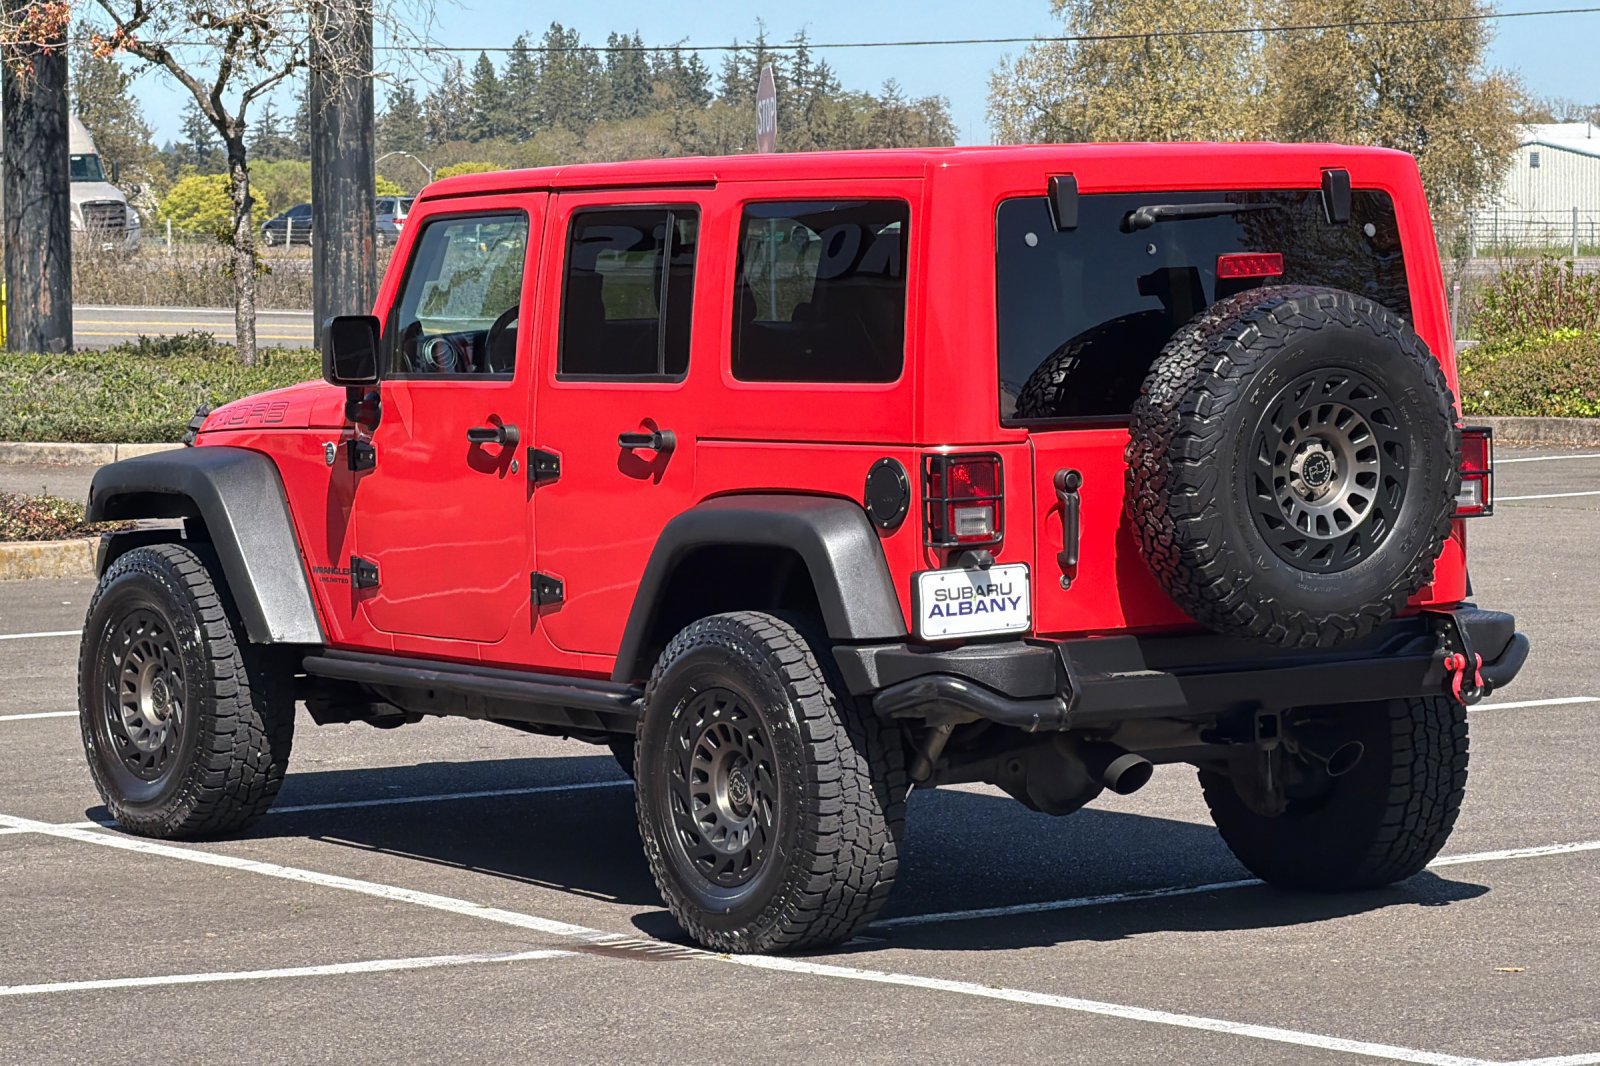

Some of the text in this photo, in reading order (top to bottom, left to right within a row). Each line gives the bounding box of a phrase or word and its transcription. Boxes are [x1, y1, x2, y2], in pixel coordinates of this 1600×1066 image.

[758, 97, 774, 134] STOP
[319, 576, 349, 584] UNLIMITED
[934, 582, 1013, 602] SUBARU
[928, 595, 1022, 619] ALBANY
